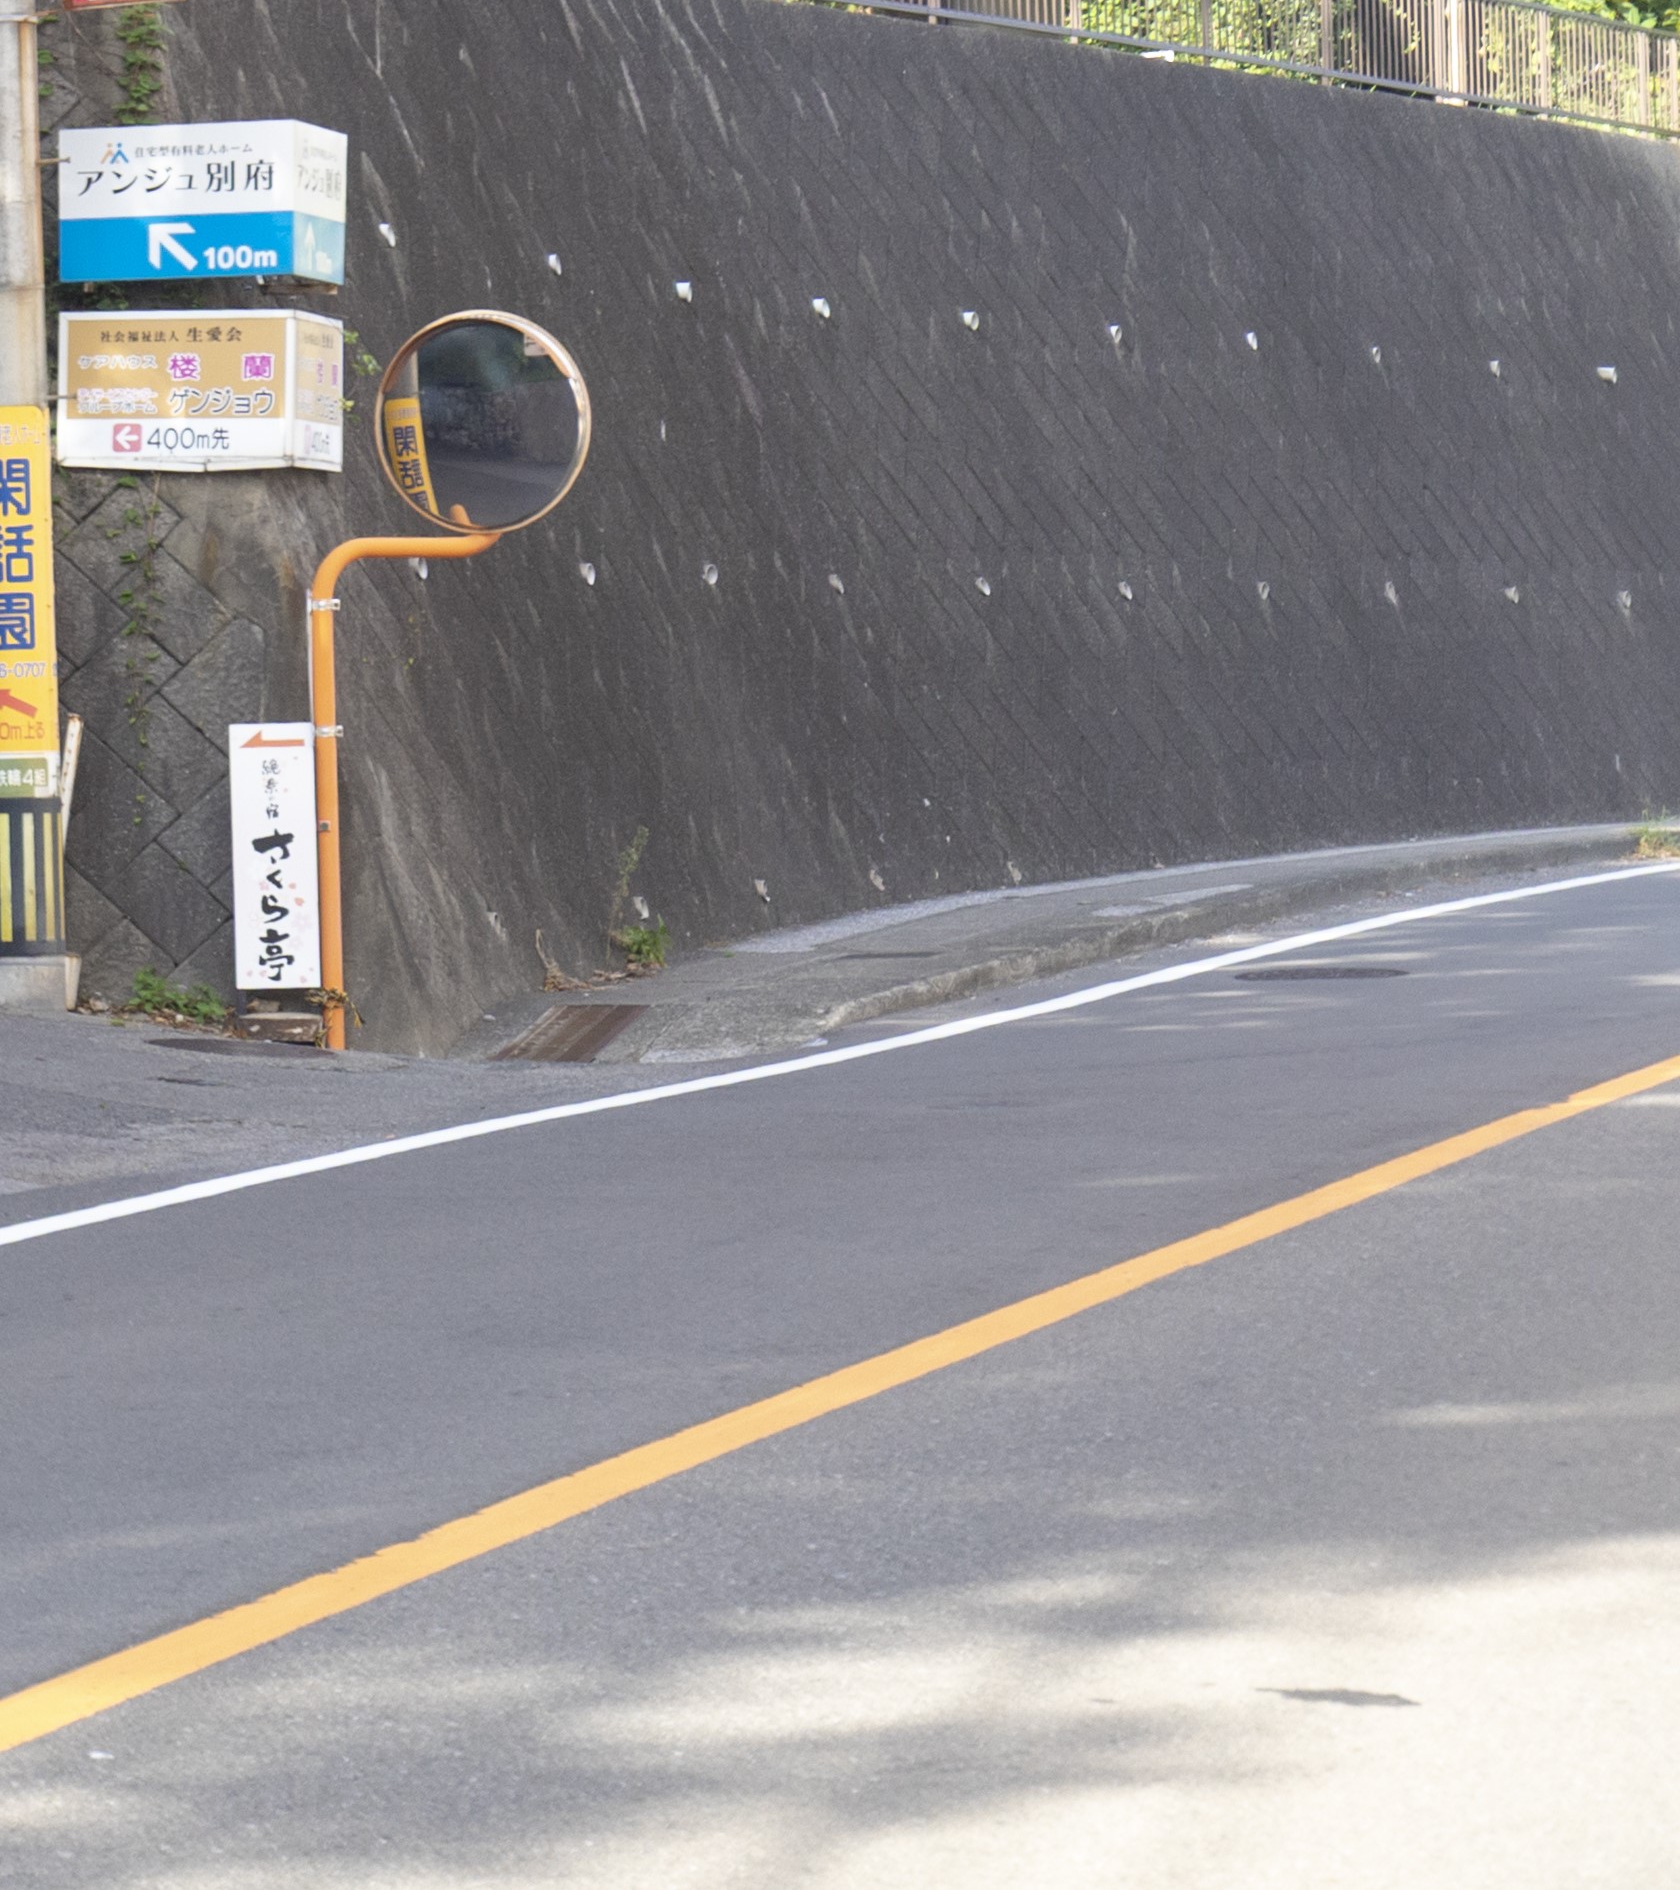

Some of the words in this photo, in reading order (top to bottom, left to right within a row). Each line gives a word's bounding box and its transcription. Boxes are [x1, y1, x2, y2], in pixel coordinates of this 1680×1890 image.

[134, 143, 253, 158] 住宅型有料老人ホーム
[77, 159, 276, 196] アンジュ別府
[203, 246, 277, 269] 100m
[147, 426, 230, 450] 400m先
[252, 829, 295, 982] さくら亭
